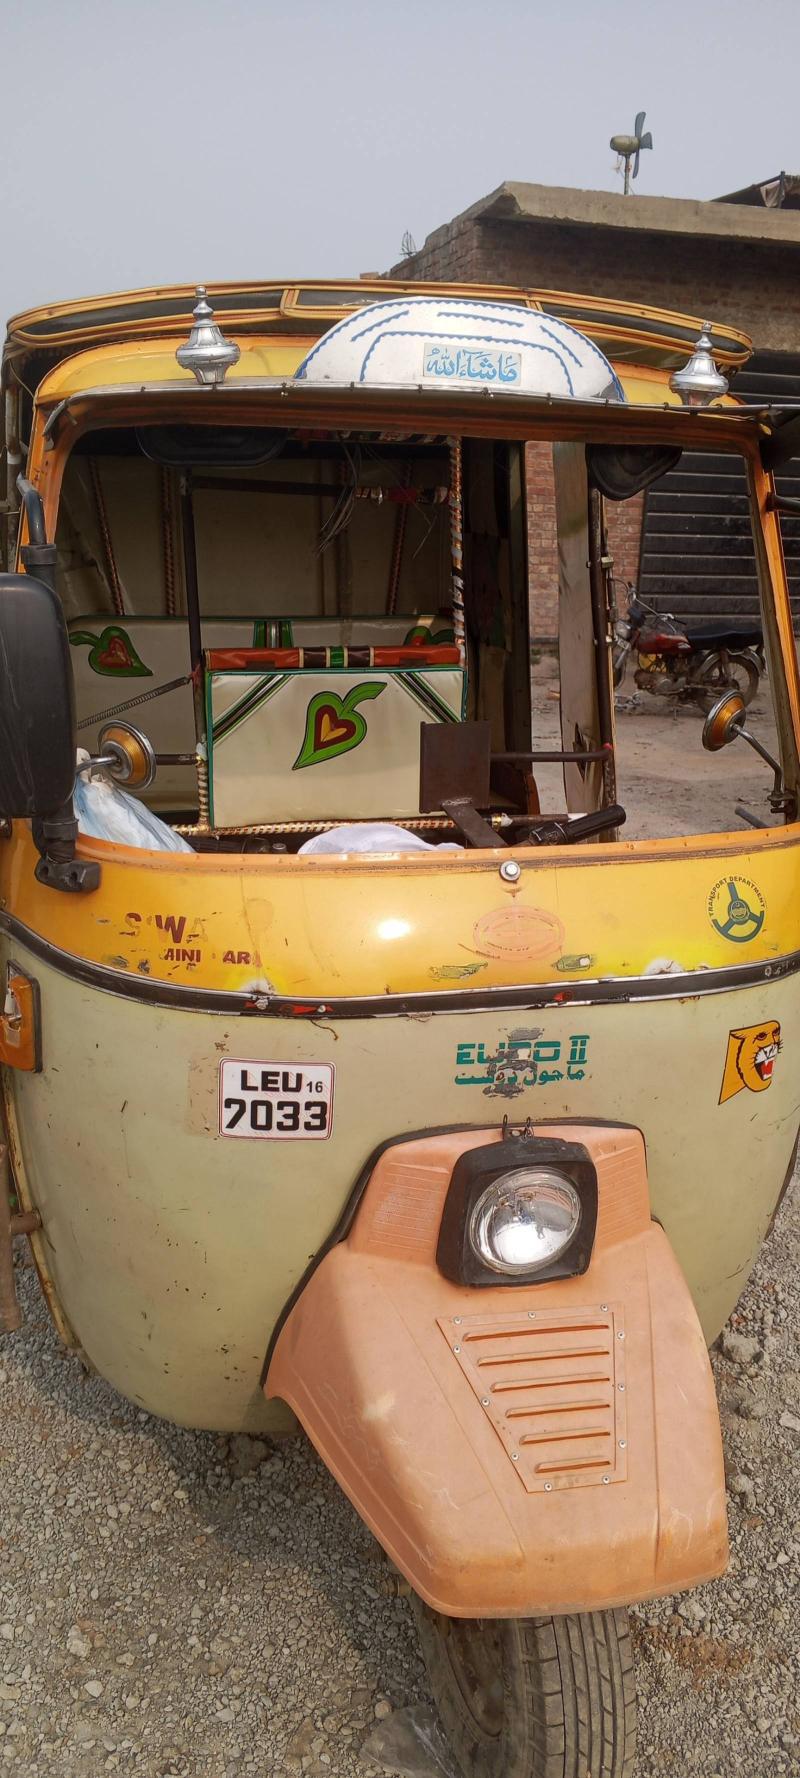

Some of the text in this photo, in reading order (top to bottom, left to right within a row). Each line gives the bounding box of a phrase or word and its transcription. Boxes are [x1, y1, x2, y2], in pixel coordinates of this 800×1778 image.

[708, 876, 765, 917] TRANSPORT DEPARTMENT
[240, 1069, 323, 1093] LEU 16
[224, 1098, 328, 1132] 7033
